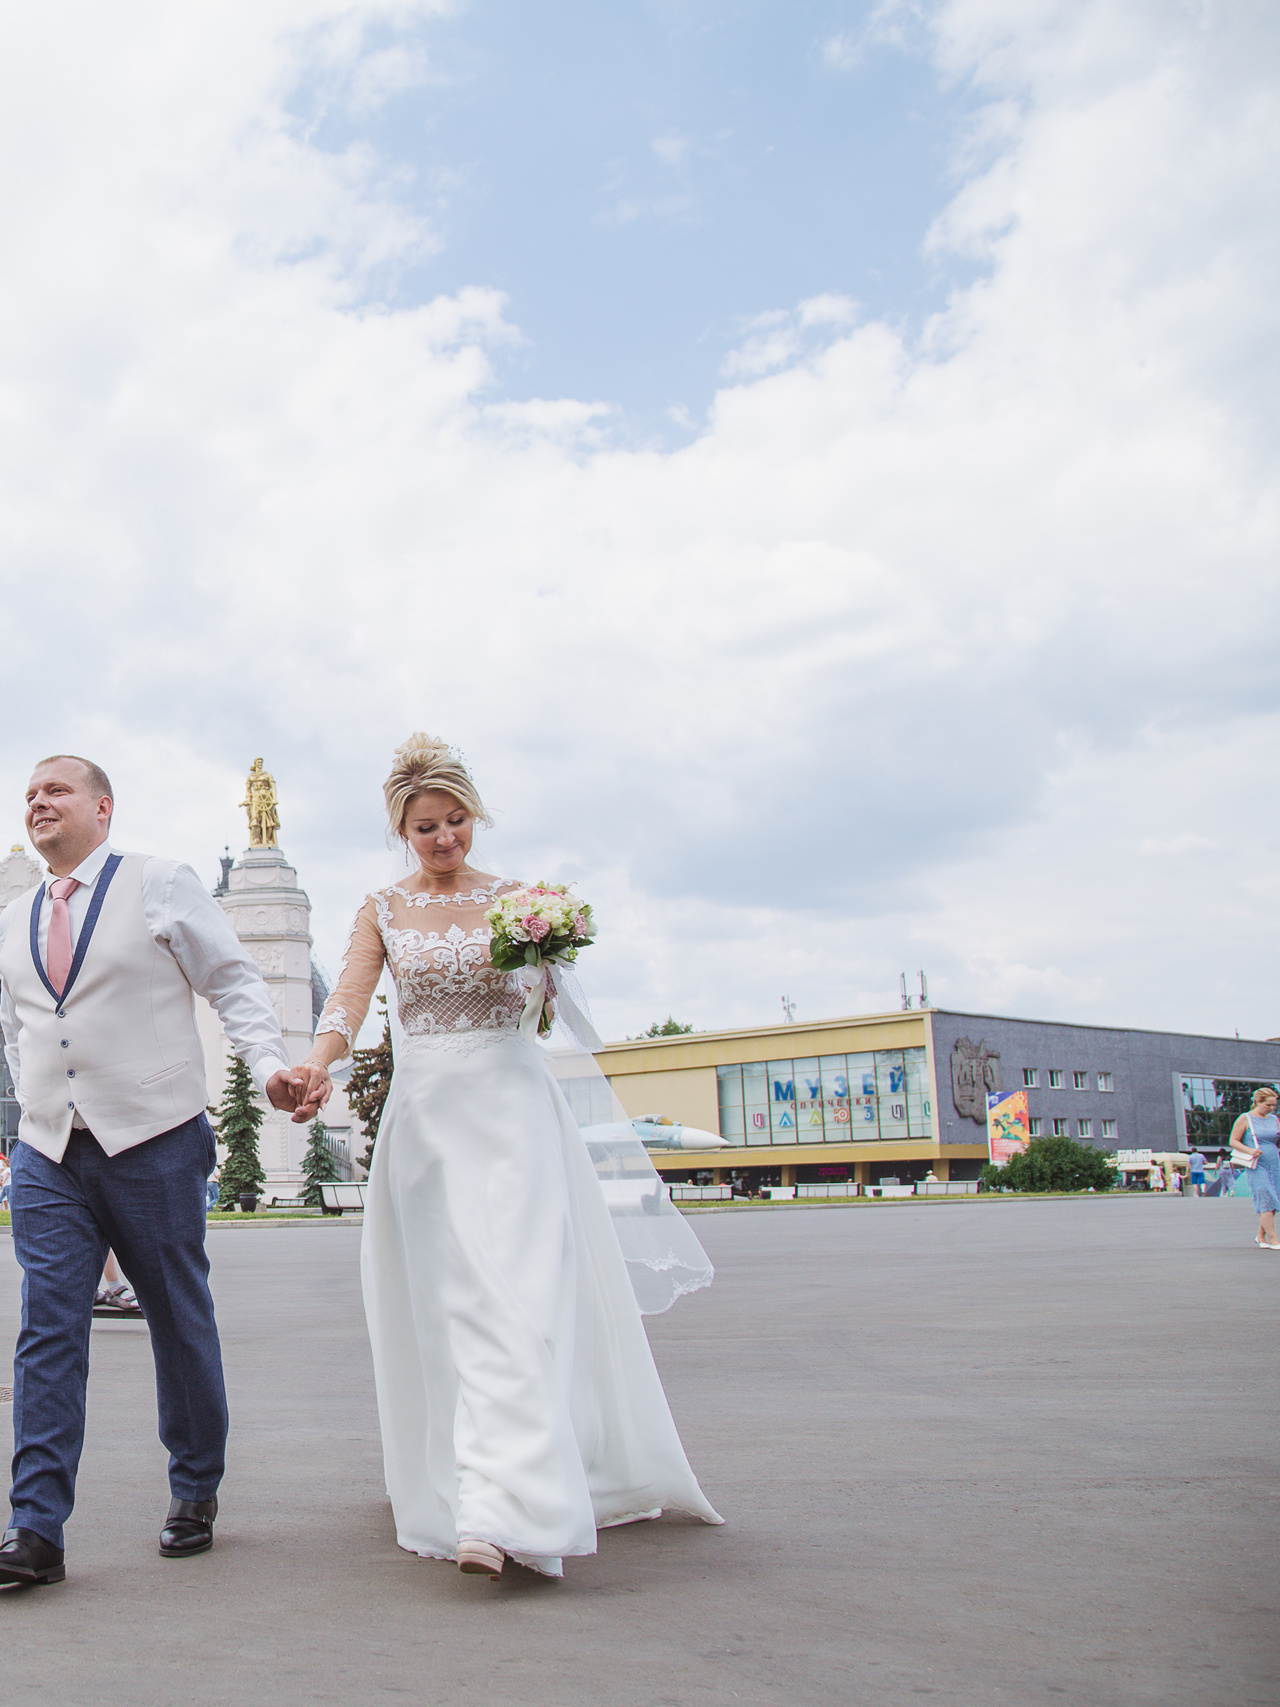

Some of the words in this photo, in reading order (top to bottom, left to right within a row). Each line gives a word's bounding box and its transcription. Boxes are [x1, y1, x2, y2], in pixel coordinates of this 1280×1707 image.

[774, 1065, 906, 1102] МУЗЕЙ
[790, 1096, 881, 1110] ОПТИЧЕСКИХ
[651, 1127, 666, 1138] 27
